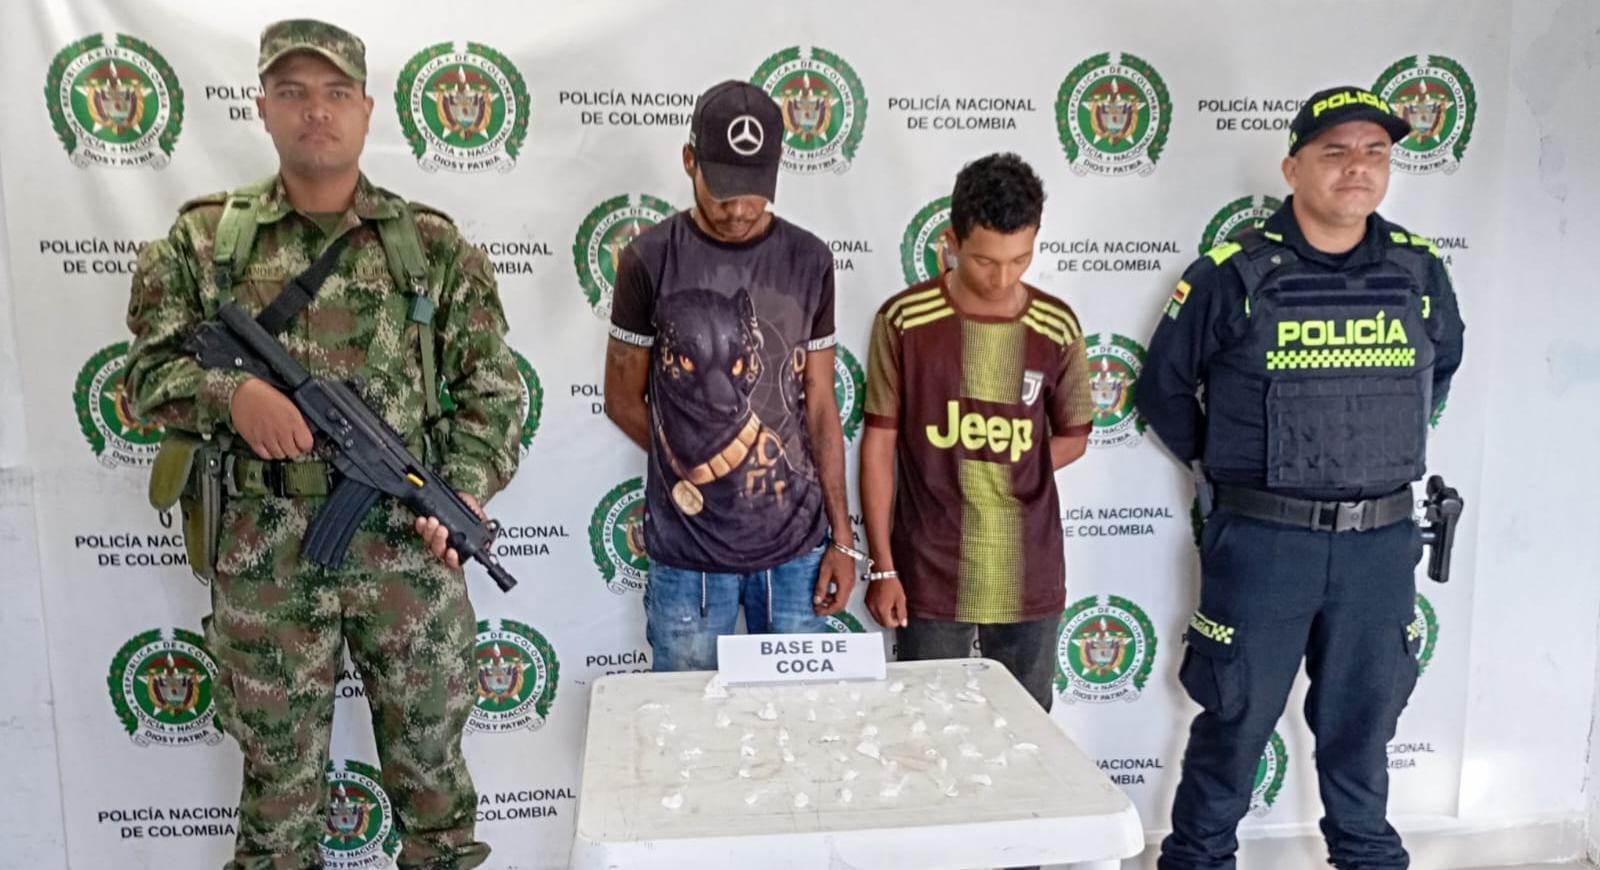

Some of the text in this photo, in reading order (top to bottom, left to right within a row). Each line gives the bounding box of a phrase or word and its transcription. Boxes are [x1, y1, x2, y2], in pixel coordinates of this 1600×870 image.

[764, 66, 791, 92] BLICA
[1383, 73, 1409, 98] BLICA
[206, 86, 261, 100] POLIC
[559, 90, 694, 107] POLICÍA NACION
[888, 96, 1036, 111] POLICÍA NACIONAL
[1198, 97, 1299, 112] POLICÍA NACI
[230, 107, 254, 120] DE
[581, 112, 604, 125] DE
[907, 117, 1017, 130] DE COLOMBIA
[1216, 118, 1291, 131] DE COLO
[40, 236, 110, 254] POLICÍA
[479, 242, 553, 255] ACIONAL
[829, 240, 873, 253] ONAL
[1040, 239, 1180, 254] POLICÍA NACIONAL
[1435, 237, 1469, 250] ONAL
[63, 260, 138, 274] DE COLO
[493, 261, 533, 274] MBIA
[1057, 259, 1162, 272] DE COLOMBIA
[1278, 310, 1408, 347] POLICÍA
[926, 400, 1033, 462] Jeep
[1065, 507, 1173, 521] ICÍA NACIONAL
[497, 526, 570, 539] ACIONAL
[1064, 525, 1155, 537] E COLOMBIA
[75, 532, 142, 549] POLICÍA
[497, 544, 550, 557] OMBIA
[97, 553, 188, 566] DE COLOM
[760, 638, 848, 655] BASE DE
[586, 650, 648, 668] POLICÍA
[776, 658, 834, 674] COCA
[1393, 742, 1435, 755] IONAL
[1110, 774, 1146, 785] MBIA
[495, 788, 577, 804] NACIONAL
[98, 806, 240, 823] POLICÍA NACIONA
[121, 824, 236, 839] DE COLOMBIA
